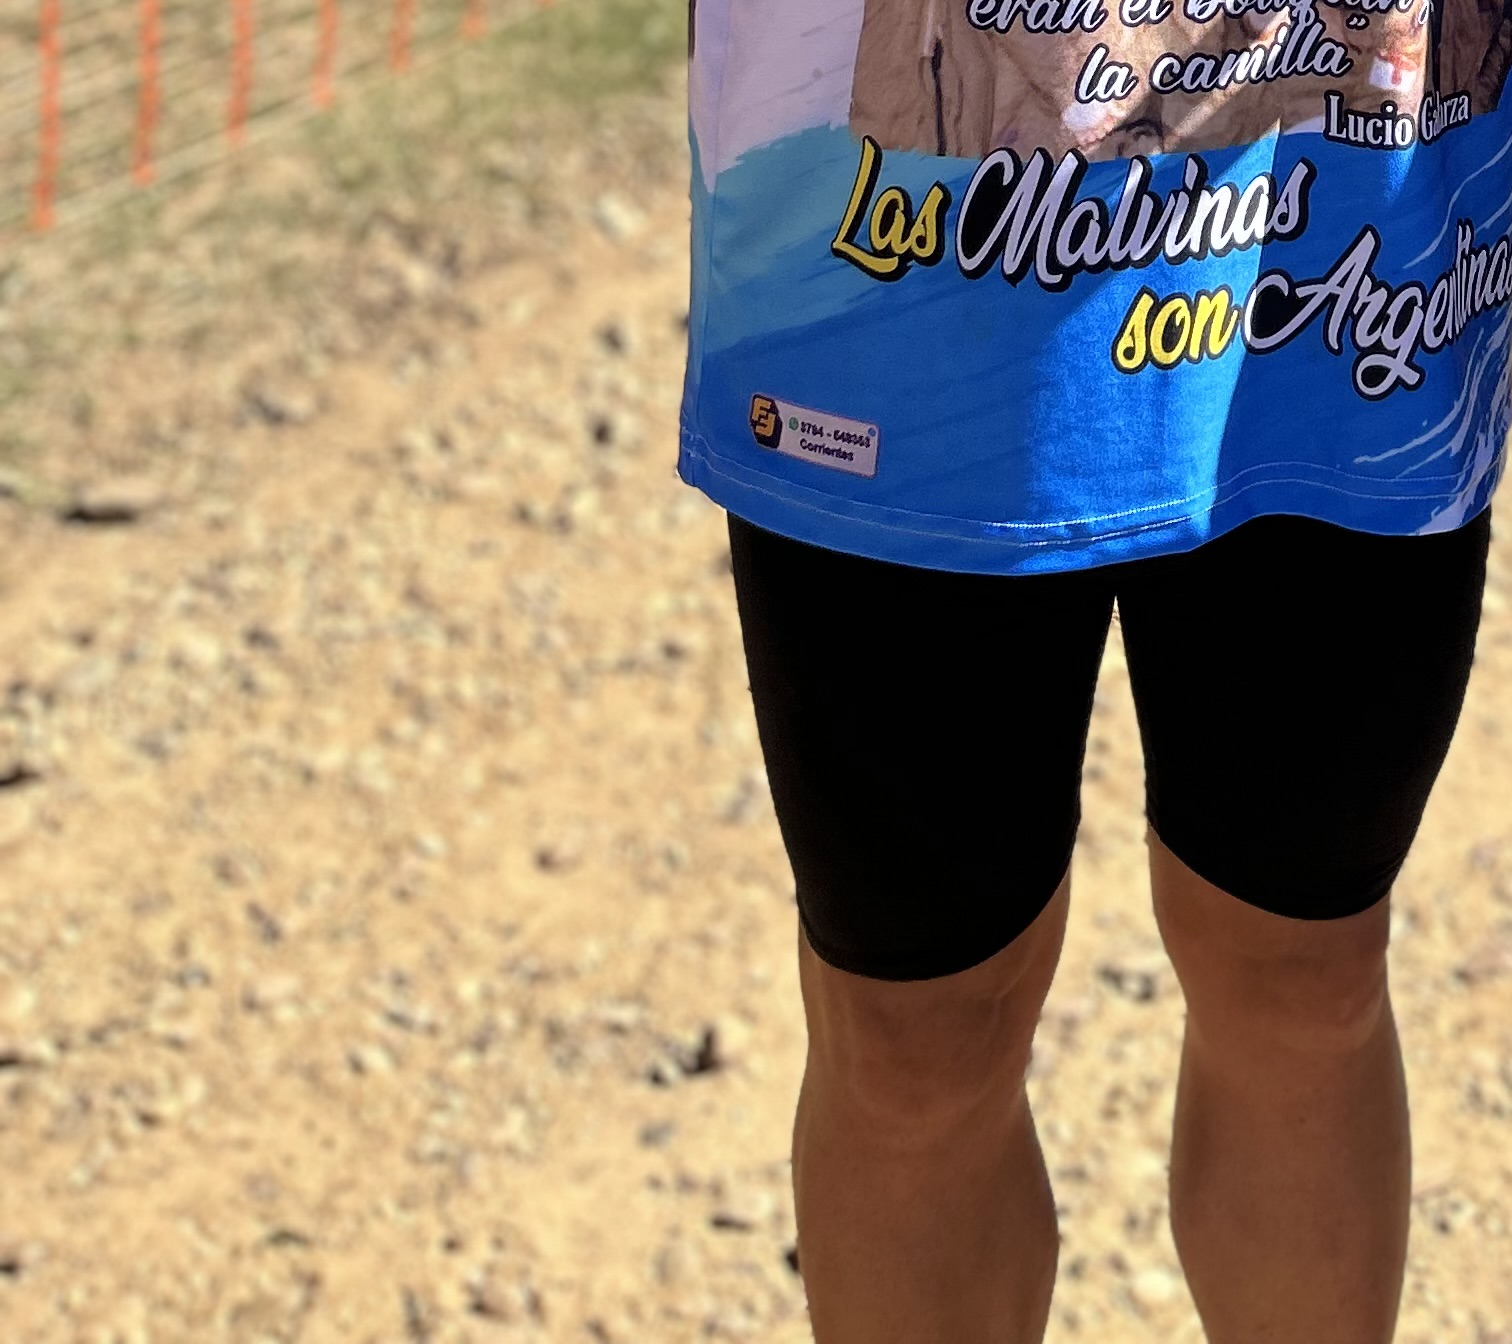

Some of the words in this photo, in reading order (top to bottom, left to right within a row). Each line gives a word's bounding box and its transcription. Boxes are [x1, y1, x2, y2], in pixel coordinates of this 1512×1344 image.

[1074, 42, 1138, 105] la
[1324, 92, 1416, 150] Lucio
[830, 135, 953, 282] Las
[953, 146, 1319, 293] Malvinas
[1111, 284, 1241, 375] son
[799, 437, 855, 462] Corrientes
